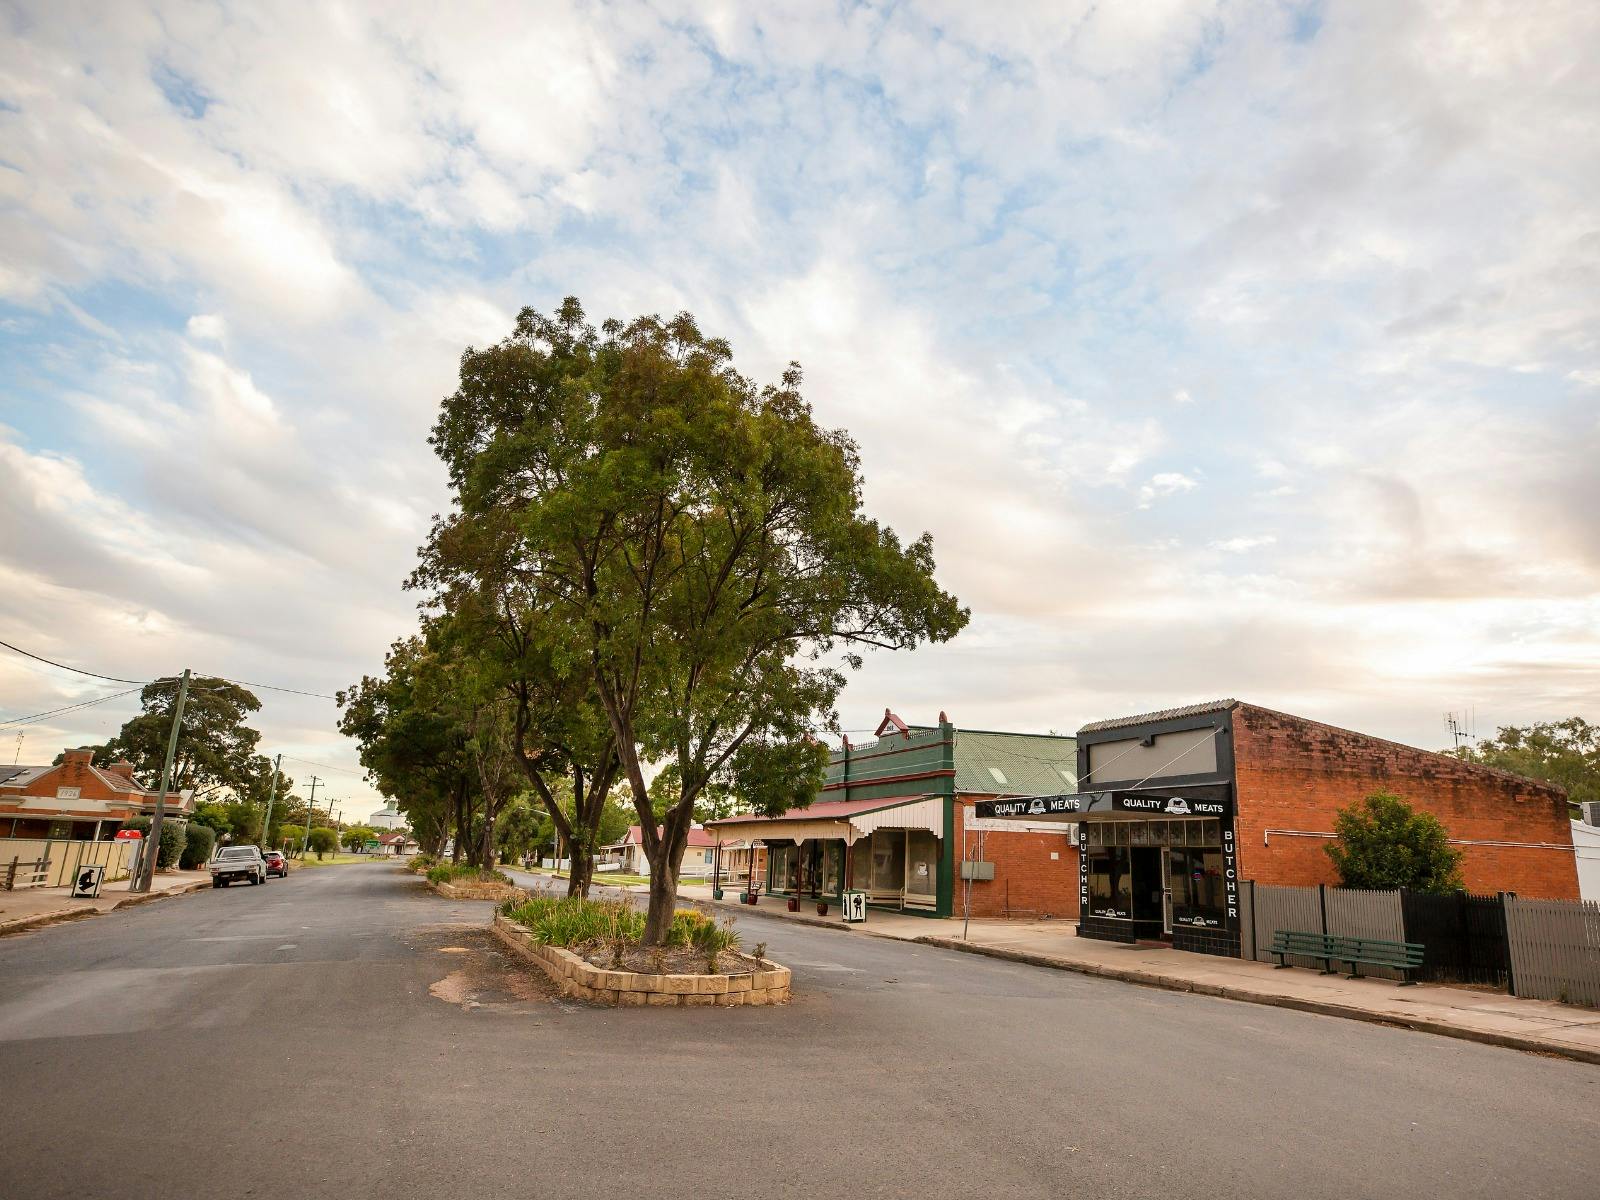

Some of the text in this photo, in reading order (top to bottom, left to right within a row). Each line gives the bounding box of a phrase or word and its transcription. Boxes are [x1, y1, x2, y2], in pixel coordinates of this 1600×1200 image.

[994, 803, 1027, 814] QUALITY
[1050, 799, 1081, 810] MEATS
[1123, 798, 1161, 808] QUALITY
[1194, 803, 1224, 813] MEATS
[1080, 832, 1088, 905] BUTCHER
[1224, 830, 1237, 918] BUTCHER
